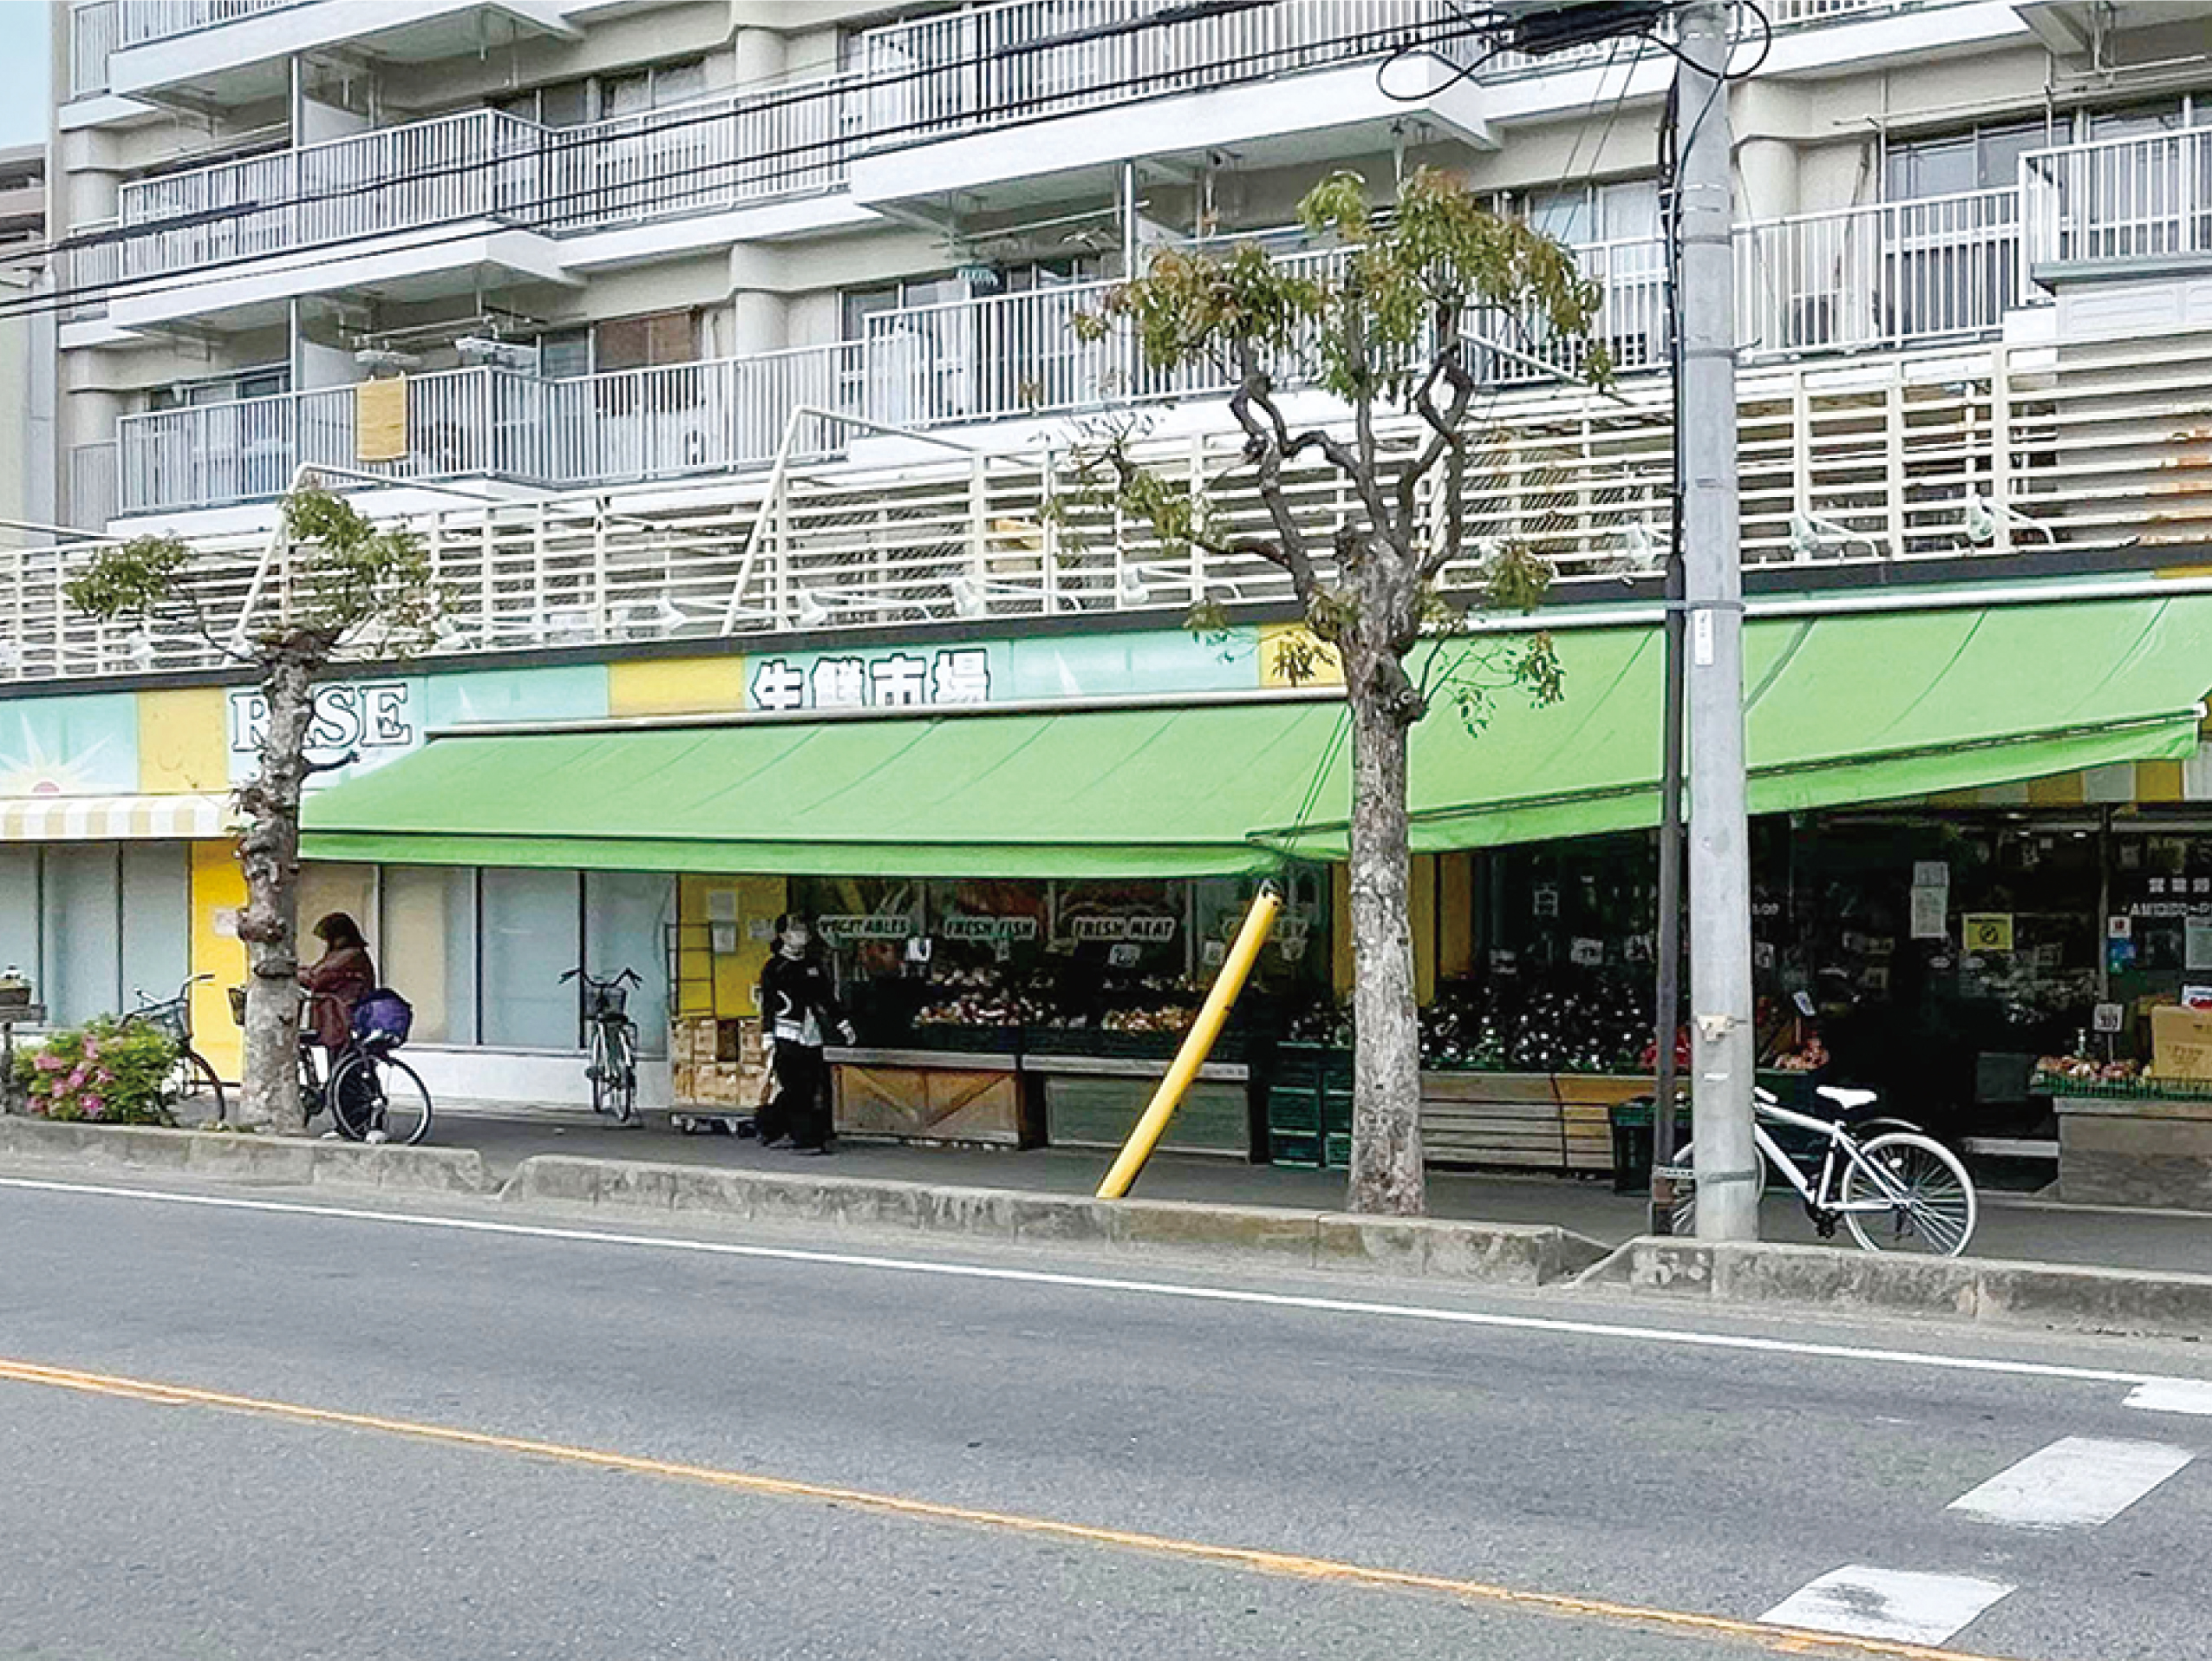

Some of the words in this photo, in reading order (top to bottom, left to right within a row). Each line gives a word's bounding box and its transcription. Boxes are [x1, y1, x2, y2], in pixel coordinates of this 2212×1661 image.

[749, 648, 992, 710] 生鮮市場
[230, 682, 413, 753] RSE
[945, 917, 995, 938] FRESH
[997, 917, 1036, 939] FISH
[1073, 917, 1126, 939] FRESH
[1129, 917, 1175, 941] MEAT
